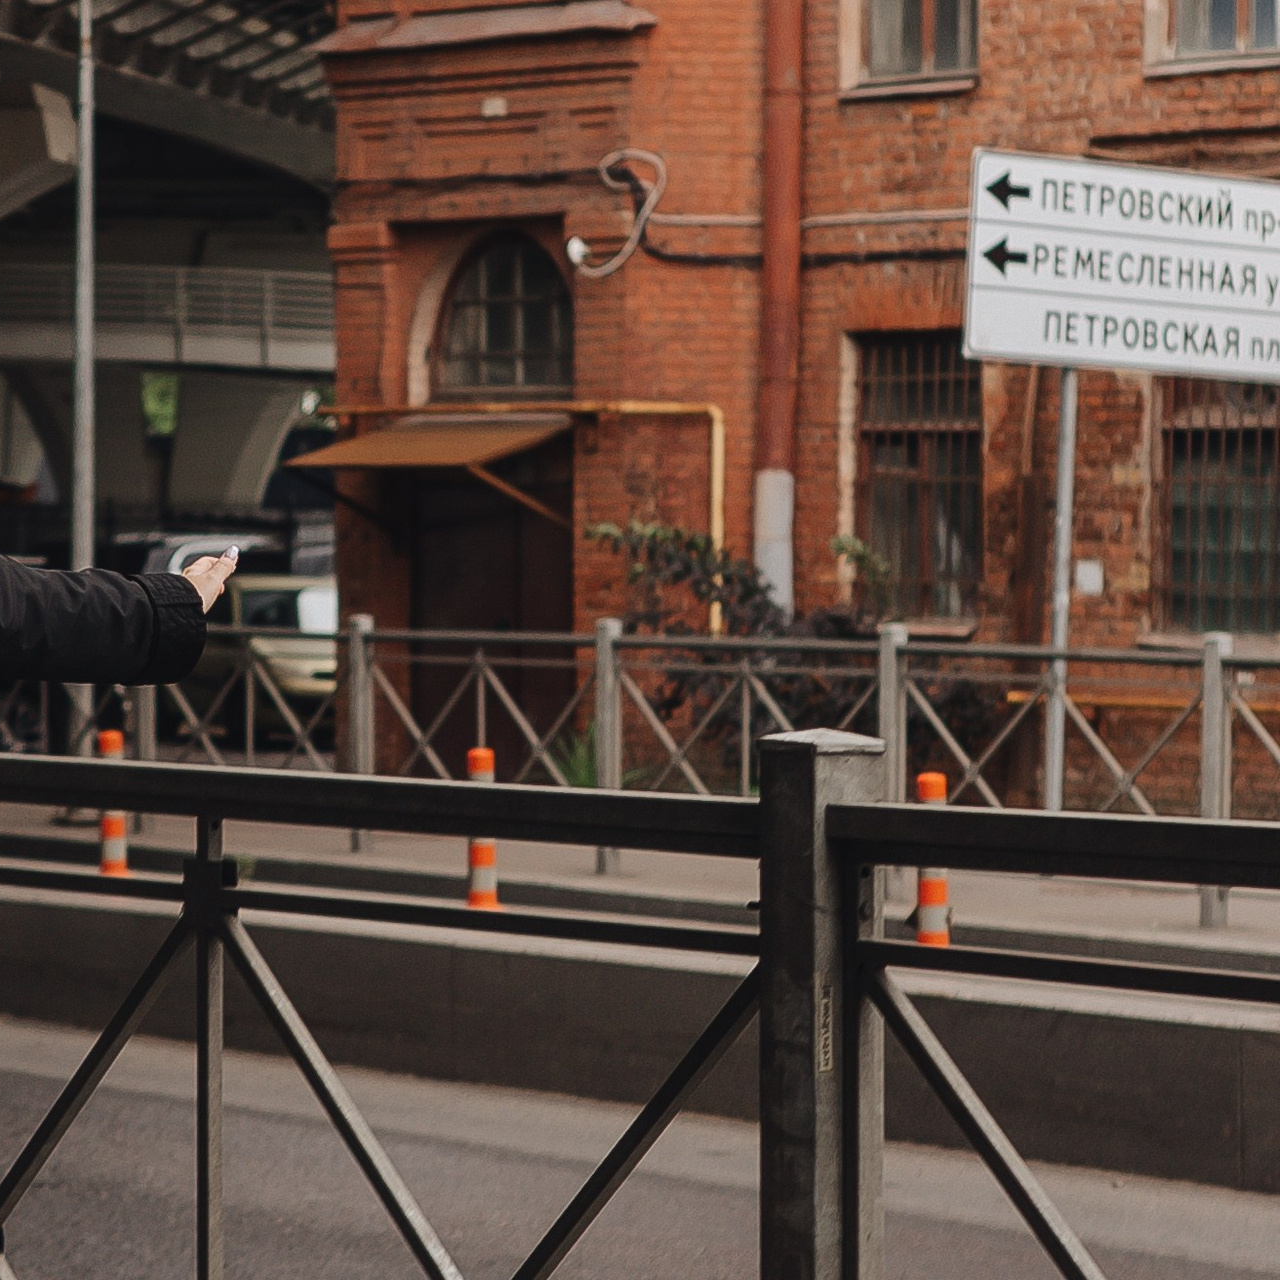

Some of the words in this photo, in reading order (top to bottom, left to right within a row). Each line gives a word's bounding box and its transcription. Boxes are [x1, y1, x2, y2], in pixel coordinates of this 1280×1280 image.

[1041, 178, 1234, 230] ПЕТРОВСКИЙ
[1245, 208, 1280, 243] пр
[1032, 244, 1257, 295] РЕМЕСЛЕННАЯ
[1044, 310, 1241, 360] ПЕТРОВСКАЯ
